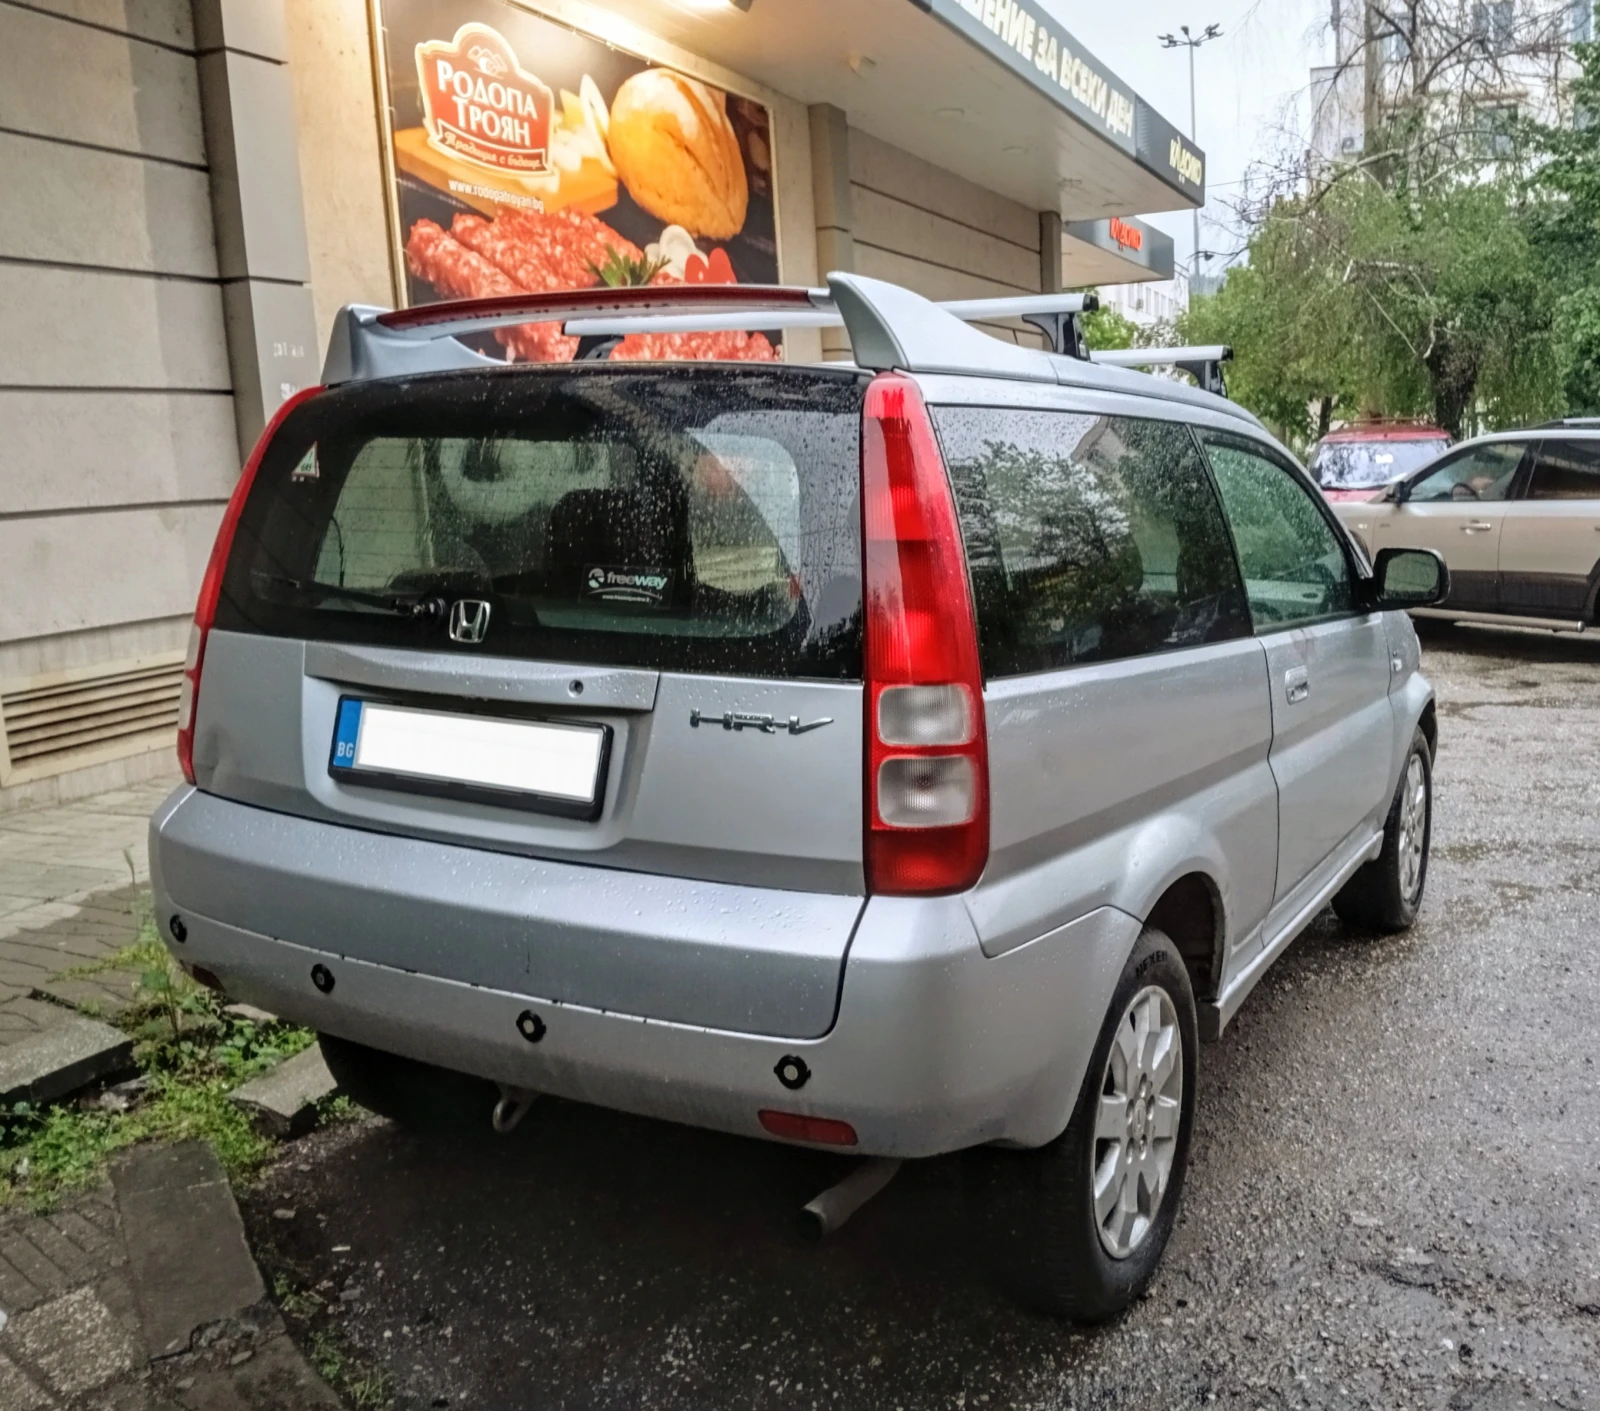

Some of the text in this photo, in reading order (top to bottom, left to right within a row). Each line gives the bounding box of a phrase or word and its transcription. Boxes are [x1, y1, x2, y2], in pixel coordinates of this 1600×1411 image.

[436, 59, 538, 121] РОДОПА
[953, 0, 1135, 138] ЕНИЕ ЗА ВСЕКИ ДЕН
[452, 95, 531, 147] ТРОЯН
[448, 179, 545, 214] www.rodopatroyan.bg
[607, 571, 668, 590] freeway
[337, 741, 354, 758] BG
